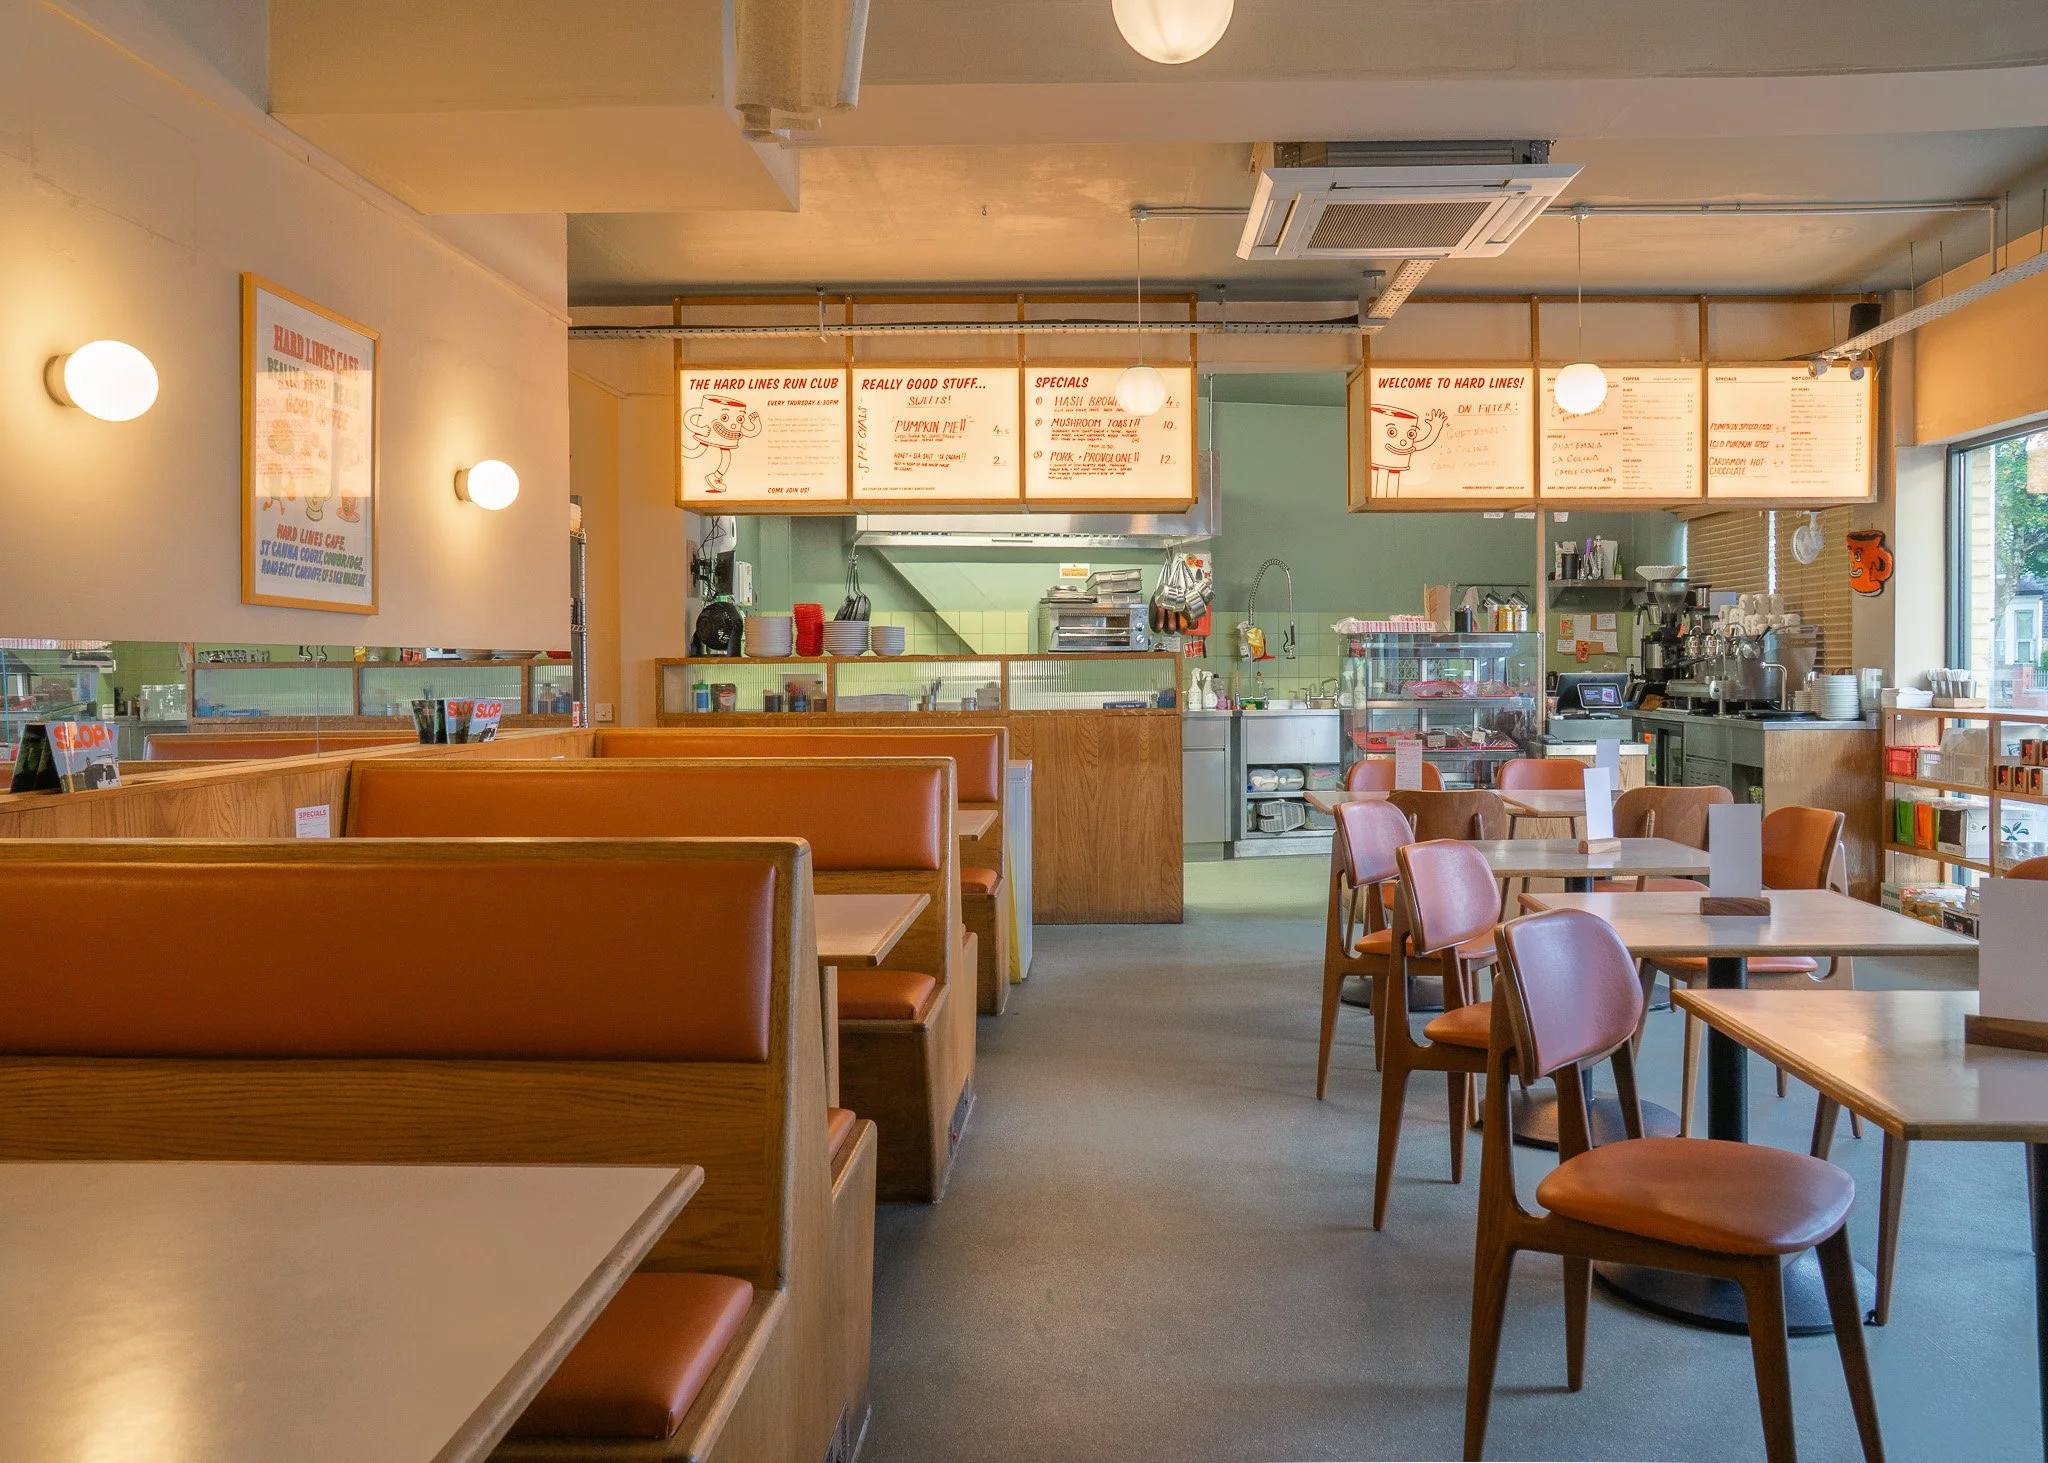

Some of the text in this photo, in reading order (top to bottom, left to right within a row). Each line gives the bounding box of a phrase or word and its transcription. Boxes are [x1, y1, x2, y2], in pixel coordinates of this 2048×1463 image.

[274, 324, 360, 380] HARD LINES CAFE
[690, 378, 839, 390] THE HARD LINES RUN CLUB
[861, 378, 986, 390] REALLY GOOD STUFF...
[1035, 377, 1089, 388] SPECIALS
[1378, 377, 1524, 388] WELCOME TO HARD LINES!
[908, 395, 951, 406] SWEETS!
[1055, 396, 1083, 406] HASH
[1458, 404, 1472, 414] ON
[894, 420, 939, 433] PUMPKIN
[1051, 418, 1101, 427] MUSHROOM
[1710, 422, 1739, 431] PUMPKIN
[858, 405, 869, 473] SPECIALS
[1725, 440, 1752, 448] PUMPKIN
[1050, 452, 1074, 462] PORK
[1709, 456, 1746, 466] CARDAMOM
[1709, 467, 1746, 475] CHOCOLATE
[276, 524, 346, 552] HARD LINES CAFE,
[260, 540, 364, 572] ST CANNA COURT, COWBRIDGE,
[262, 559, 278, 575] ROAD
[278, 561, 295, 577] EAST
[475, 703, 502, 718] SLOP
[53, 724, 106, 750] SLOP
[298, 810, 326, 819] SPECIALS
